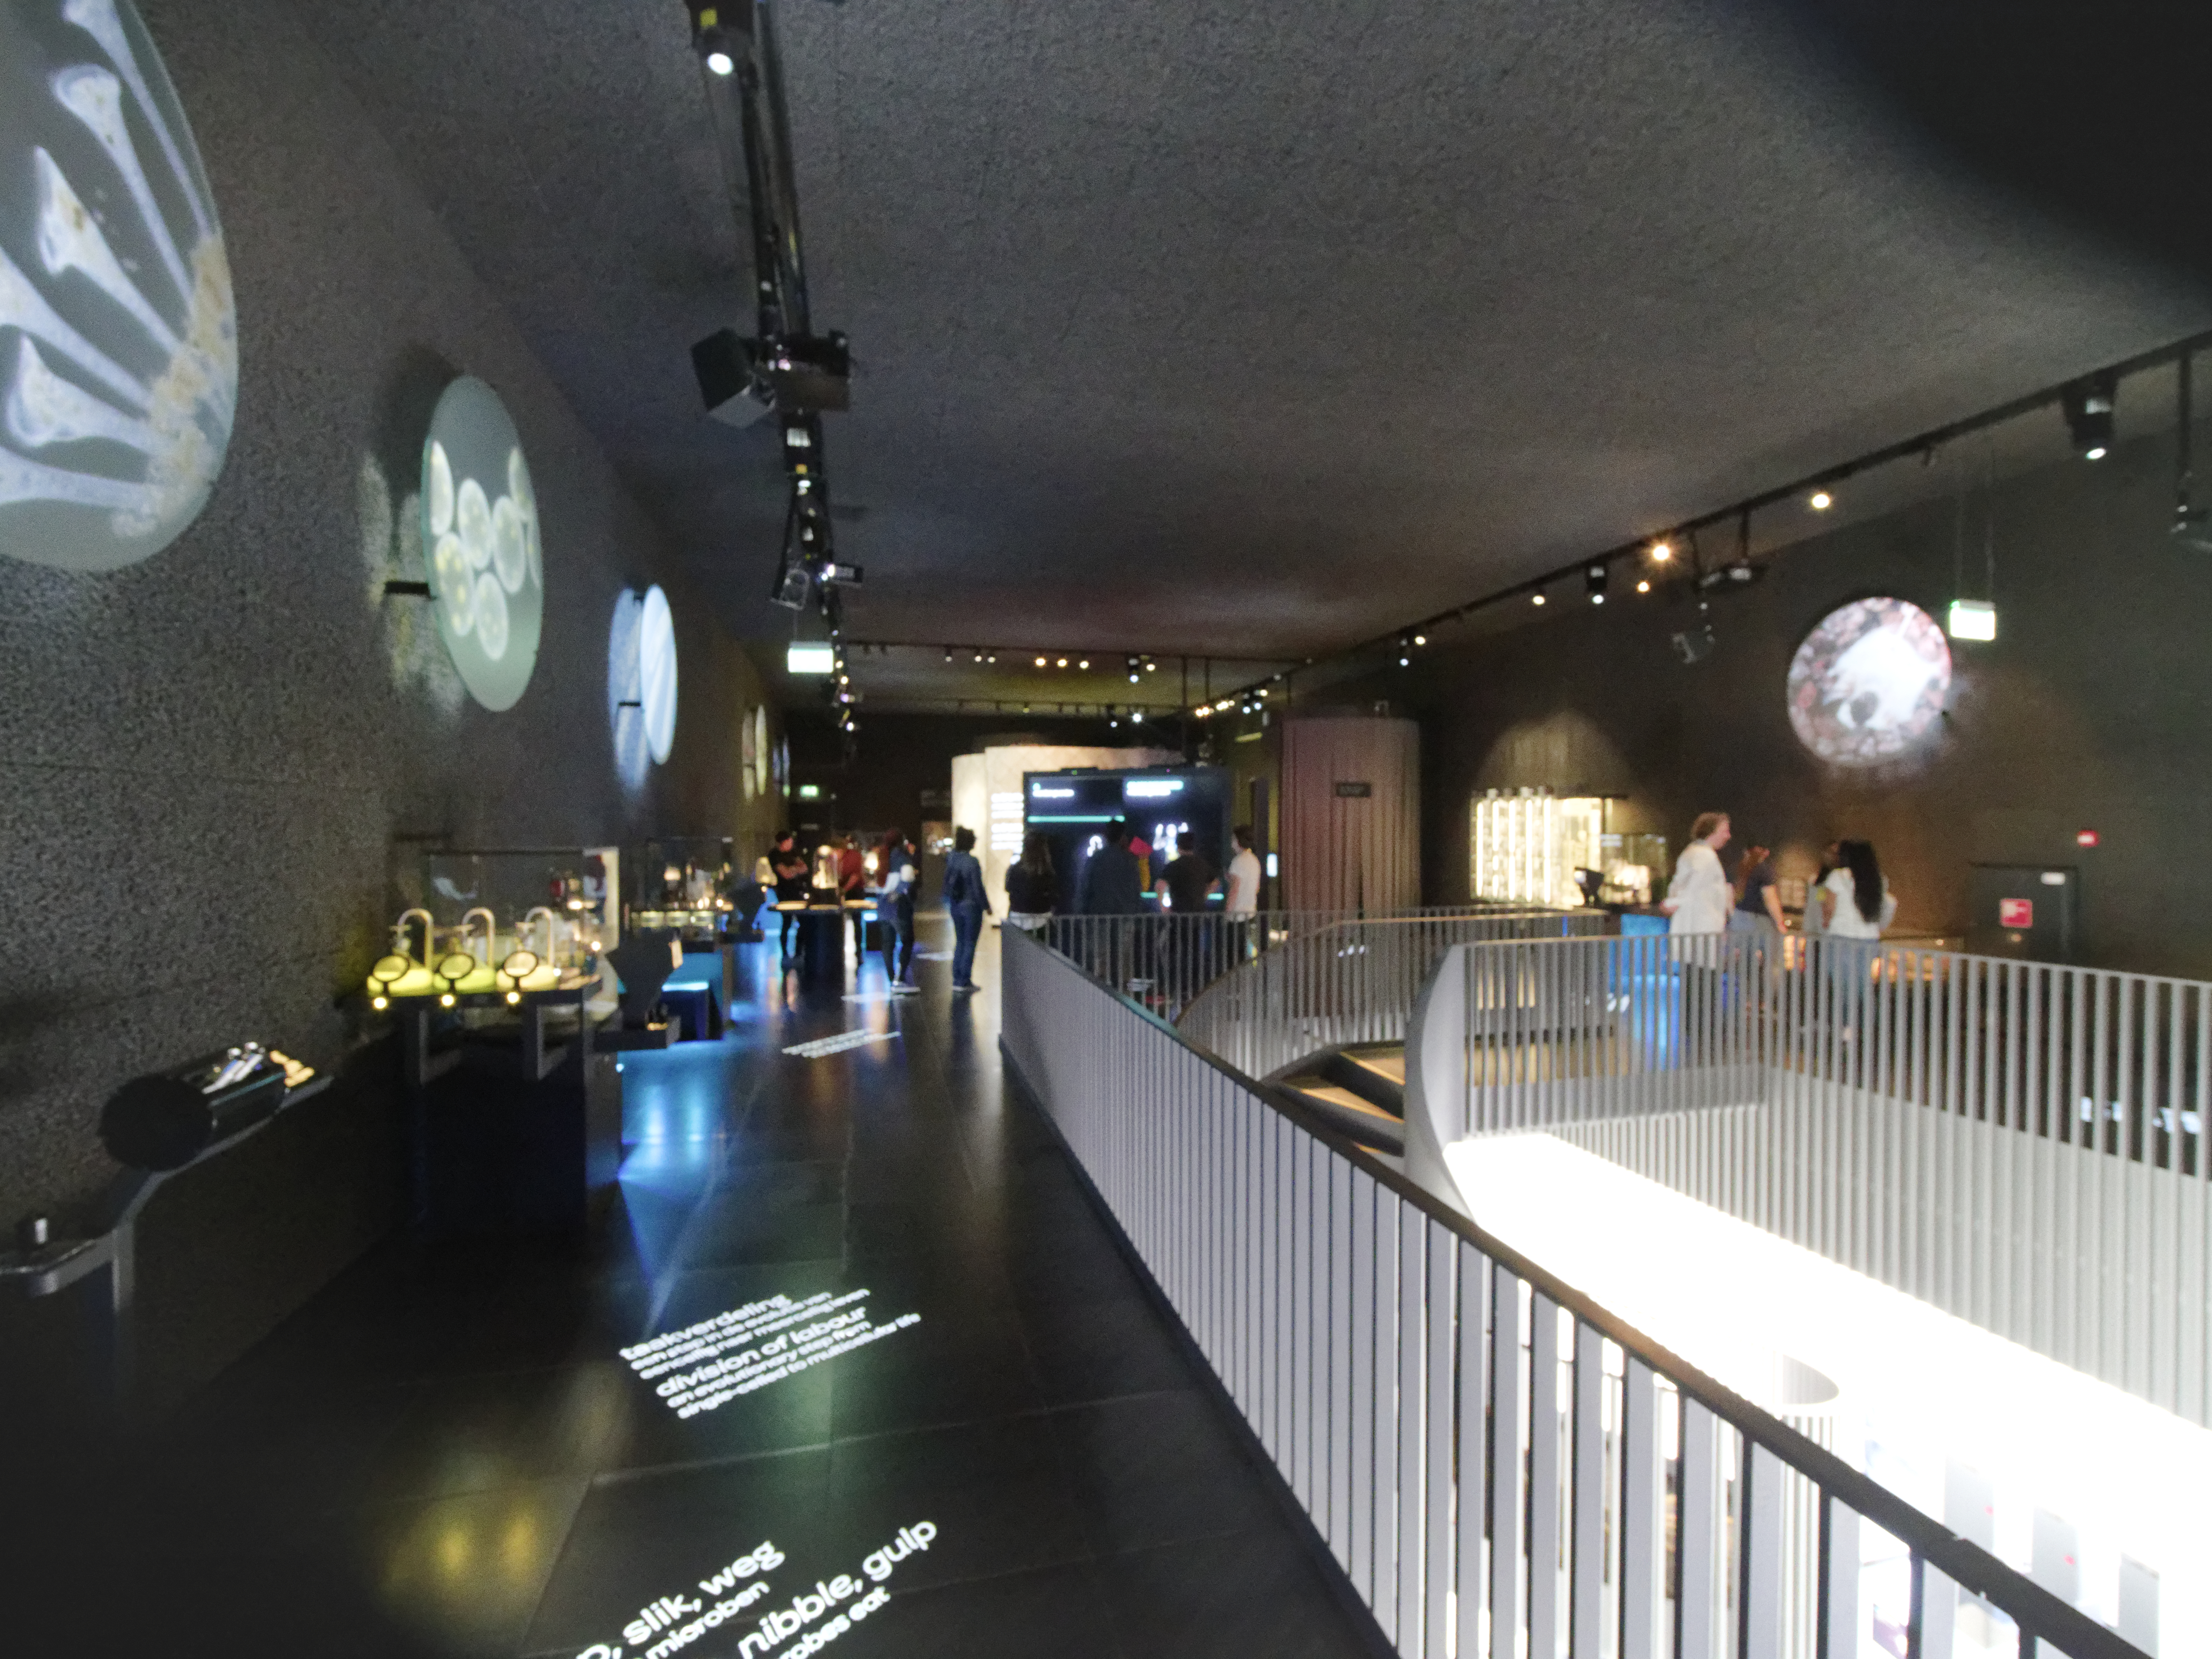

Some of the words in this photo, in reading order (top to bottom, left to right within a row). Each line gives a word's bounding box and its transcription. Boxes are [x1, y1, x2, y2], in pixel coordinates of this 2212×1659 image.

[655, 1349, 762, 1397] division
[761, 1333, 788, 1356] of
[789, 1306, 867, 1345] labour
[623, 1593, 702, 1646] slik,
[698, 1540, 786, 1596] weg
[645, 1580, 771, 1659] microben
[737, 1574, 863, 1659] nibble,
[862, 1520, 937, 1581] gulp
[848, 1586, 891, 1621] eat
